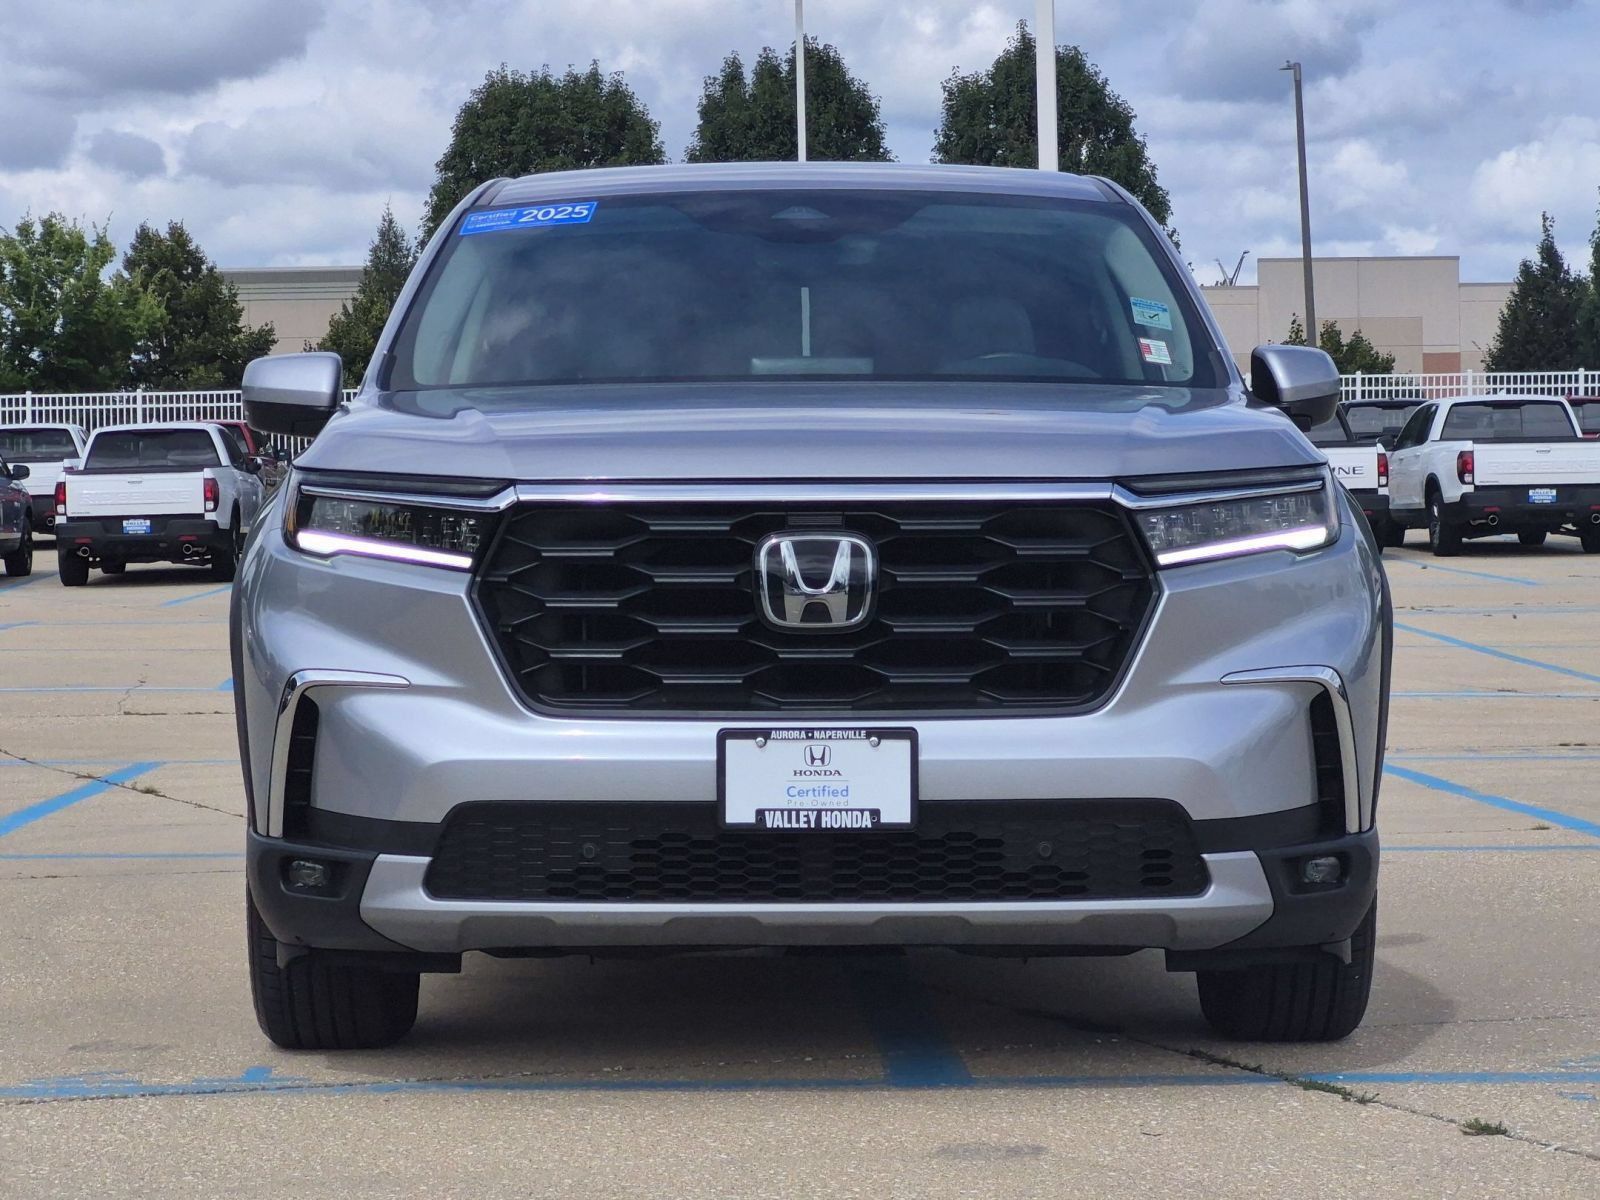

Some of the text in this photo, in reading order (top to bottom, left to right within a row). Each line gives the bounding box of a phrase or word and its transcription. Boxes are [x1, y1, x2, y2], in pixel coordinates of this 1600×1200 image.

[470, 210, 517, 221] Certified
[518, 205, 590, 222] 2025
[770, 730, 867, 740] AURORA NAPERVILLE
[793, 769, 843, 777] HONDA
[786, 785, 849, 798] Certified
[787, 799, 849, 807] Pre-Owned
[764, 811, 872, 828] VALLEY HONDA
